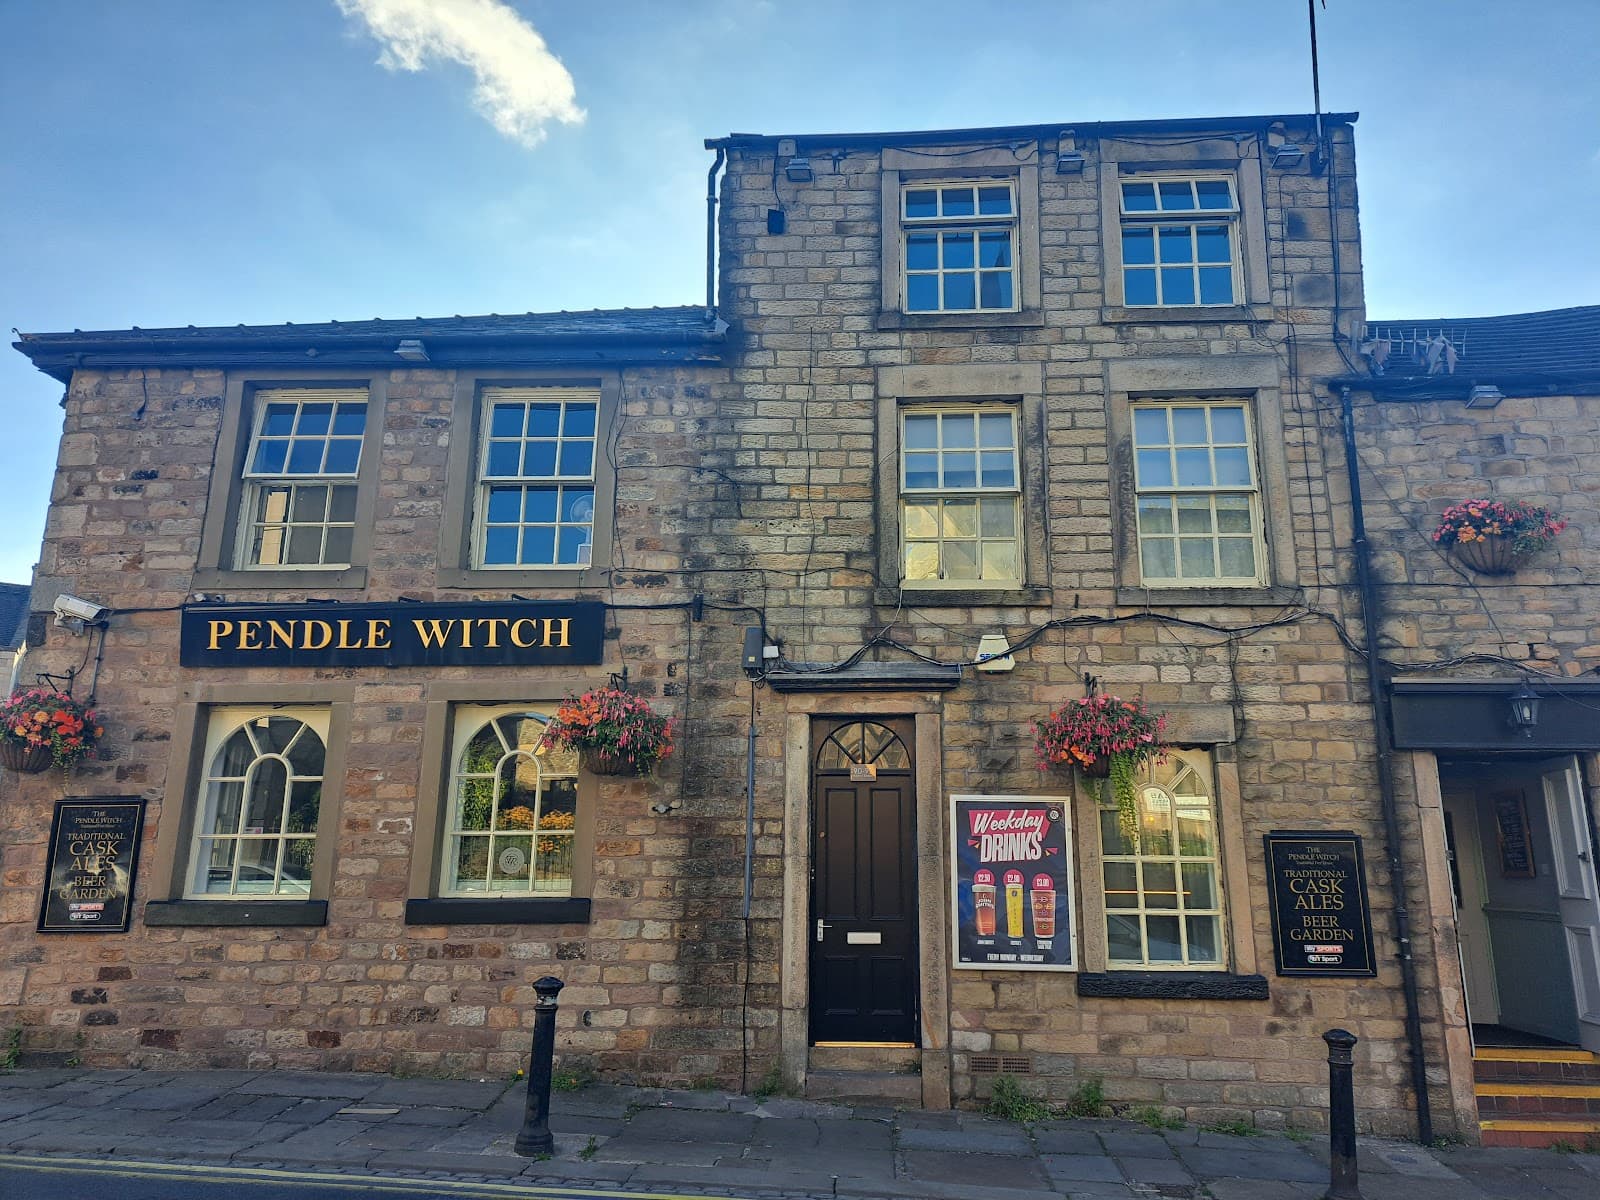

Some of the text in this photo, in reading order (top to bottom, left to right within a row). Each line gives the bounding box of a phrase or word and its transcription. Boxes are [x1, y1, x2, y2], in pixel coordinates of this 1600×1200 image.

[206, 618, 573, 650] PENDLE WITCH
[973, 809, 1044, 835] Weekday
[68, 832, 127, 841] TRADITIONAL
[69, 841, 119, 856] CASK
[980, 831, 1043, 863] DRINKS
[69, 856, 116, 871] ALES
[1288, 853, 1340, 861] PENDLE WITCH
[1283, 869, 1349, 878] TRADITIONAL
[73, 875, 106, 887] BEER
[1289, 878, 1345, 894] CASK
[59, 888, 118, 900] GARDEN
[1293, 894, 1345, 910] ALES
[1302, 915, 1340, 928] BEER
[1290, 928, 1354, 941] GARDEN
